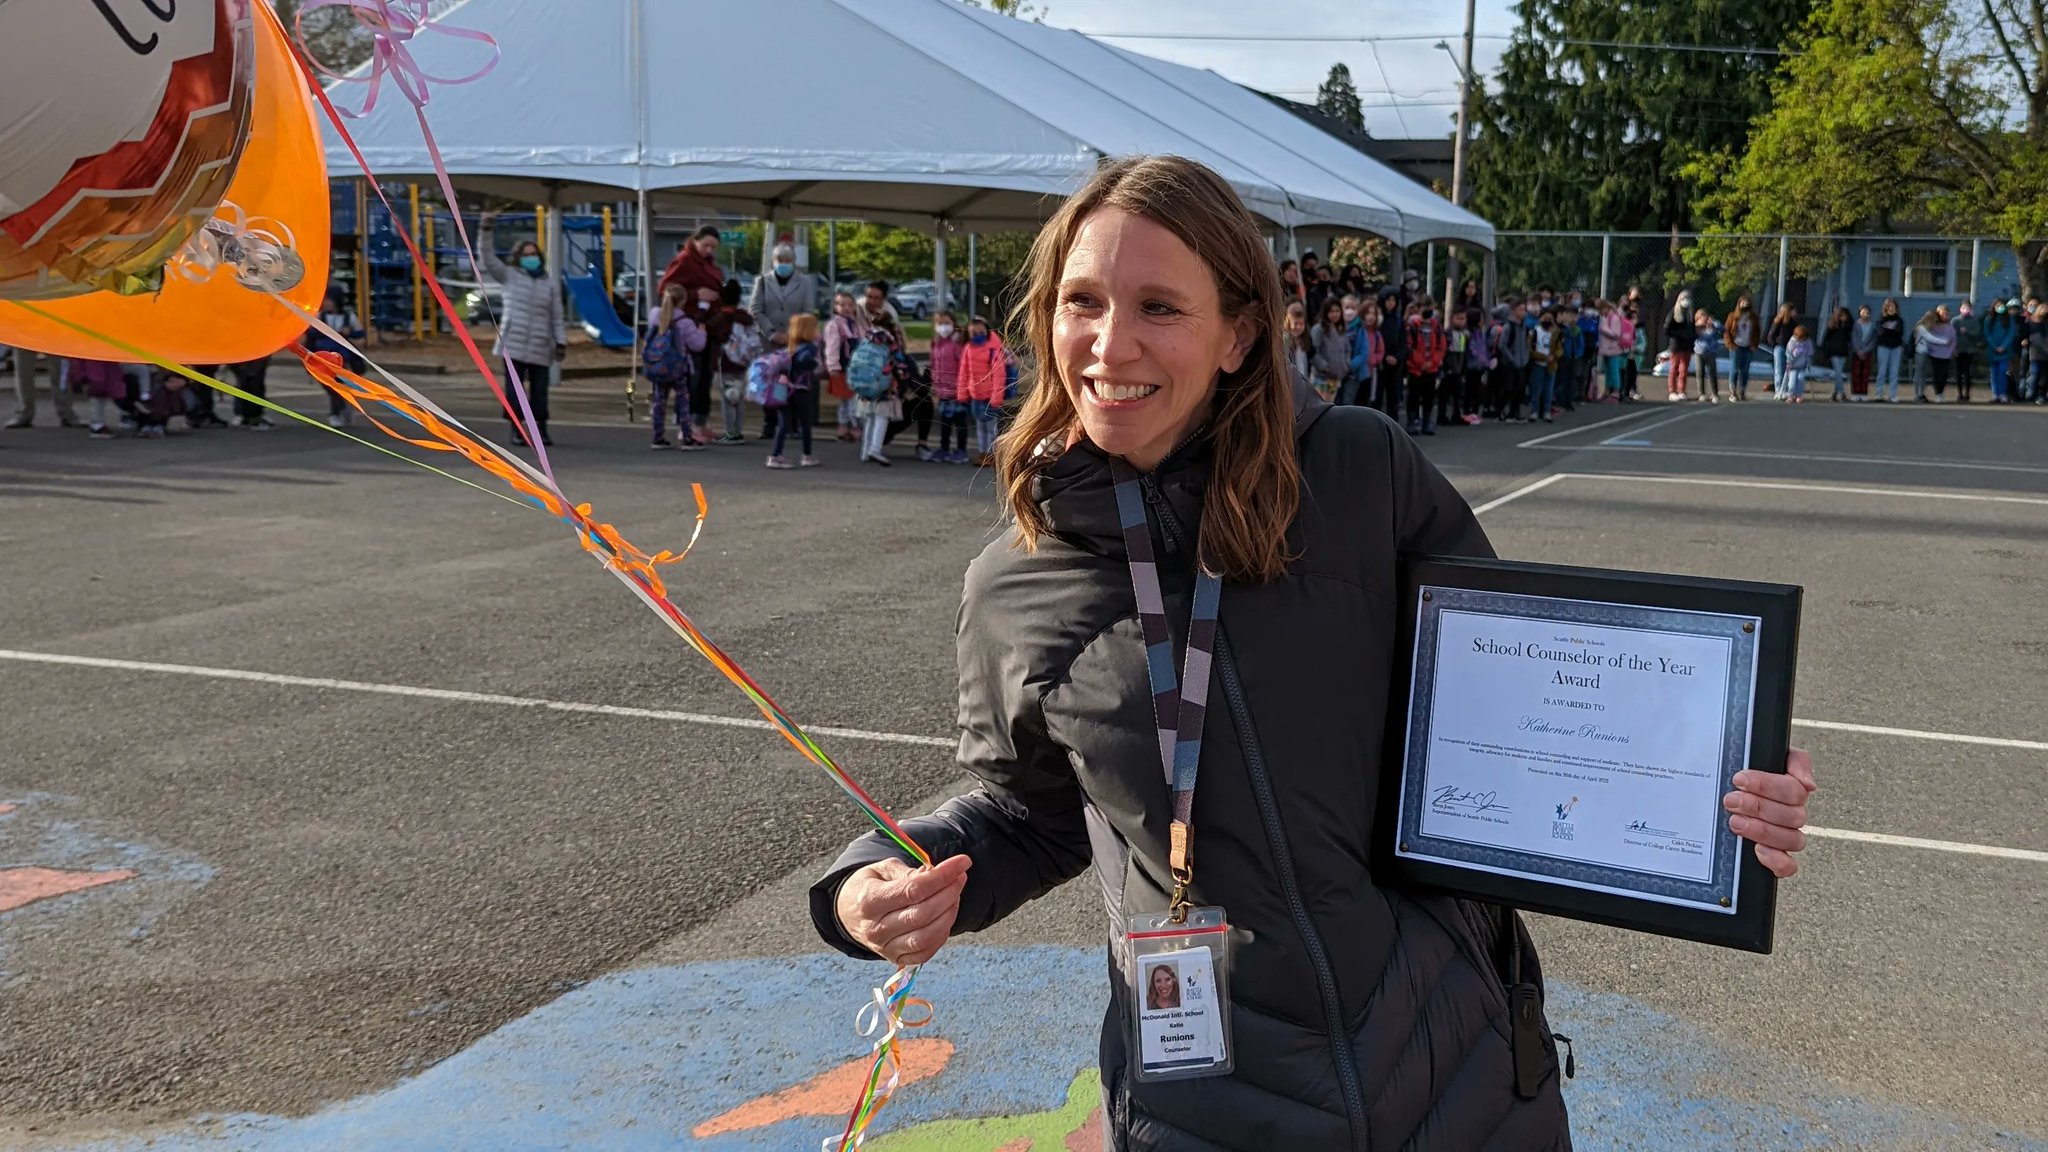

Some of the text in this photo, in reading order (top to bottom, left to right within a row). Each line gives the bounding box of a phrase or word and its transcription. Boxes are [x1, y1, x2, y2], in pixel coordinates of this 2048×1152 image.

[1472, 637, 1696, 676] School Counselor of the Year
[1551, 670, 1601, 689] Award
[1543, 697, 1605, 712] IS AWARDED TO
[1518, 715, 1630, 744] Katherine Runions
[1142, 1012, 1170, 1021] McDonald
[1184, 1010, 1204, 1018] School
[1160, 1034, 1195, 1043] Runions
